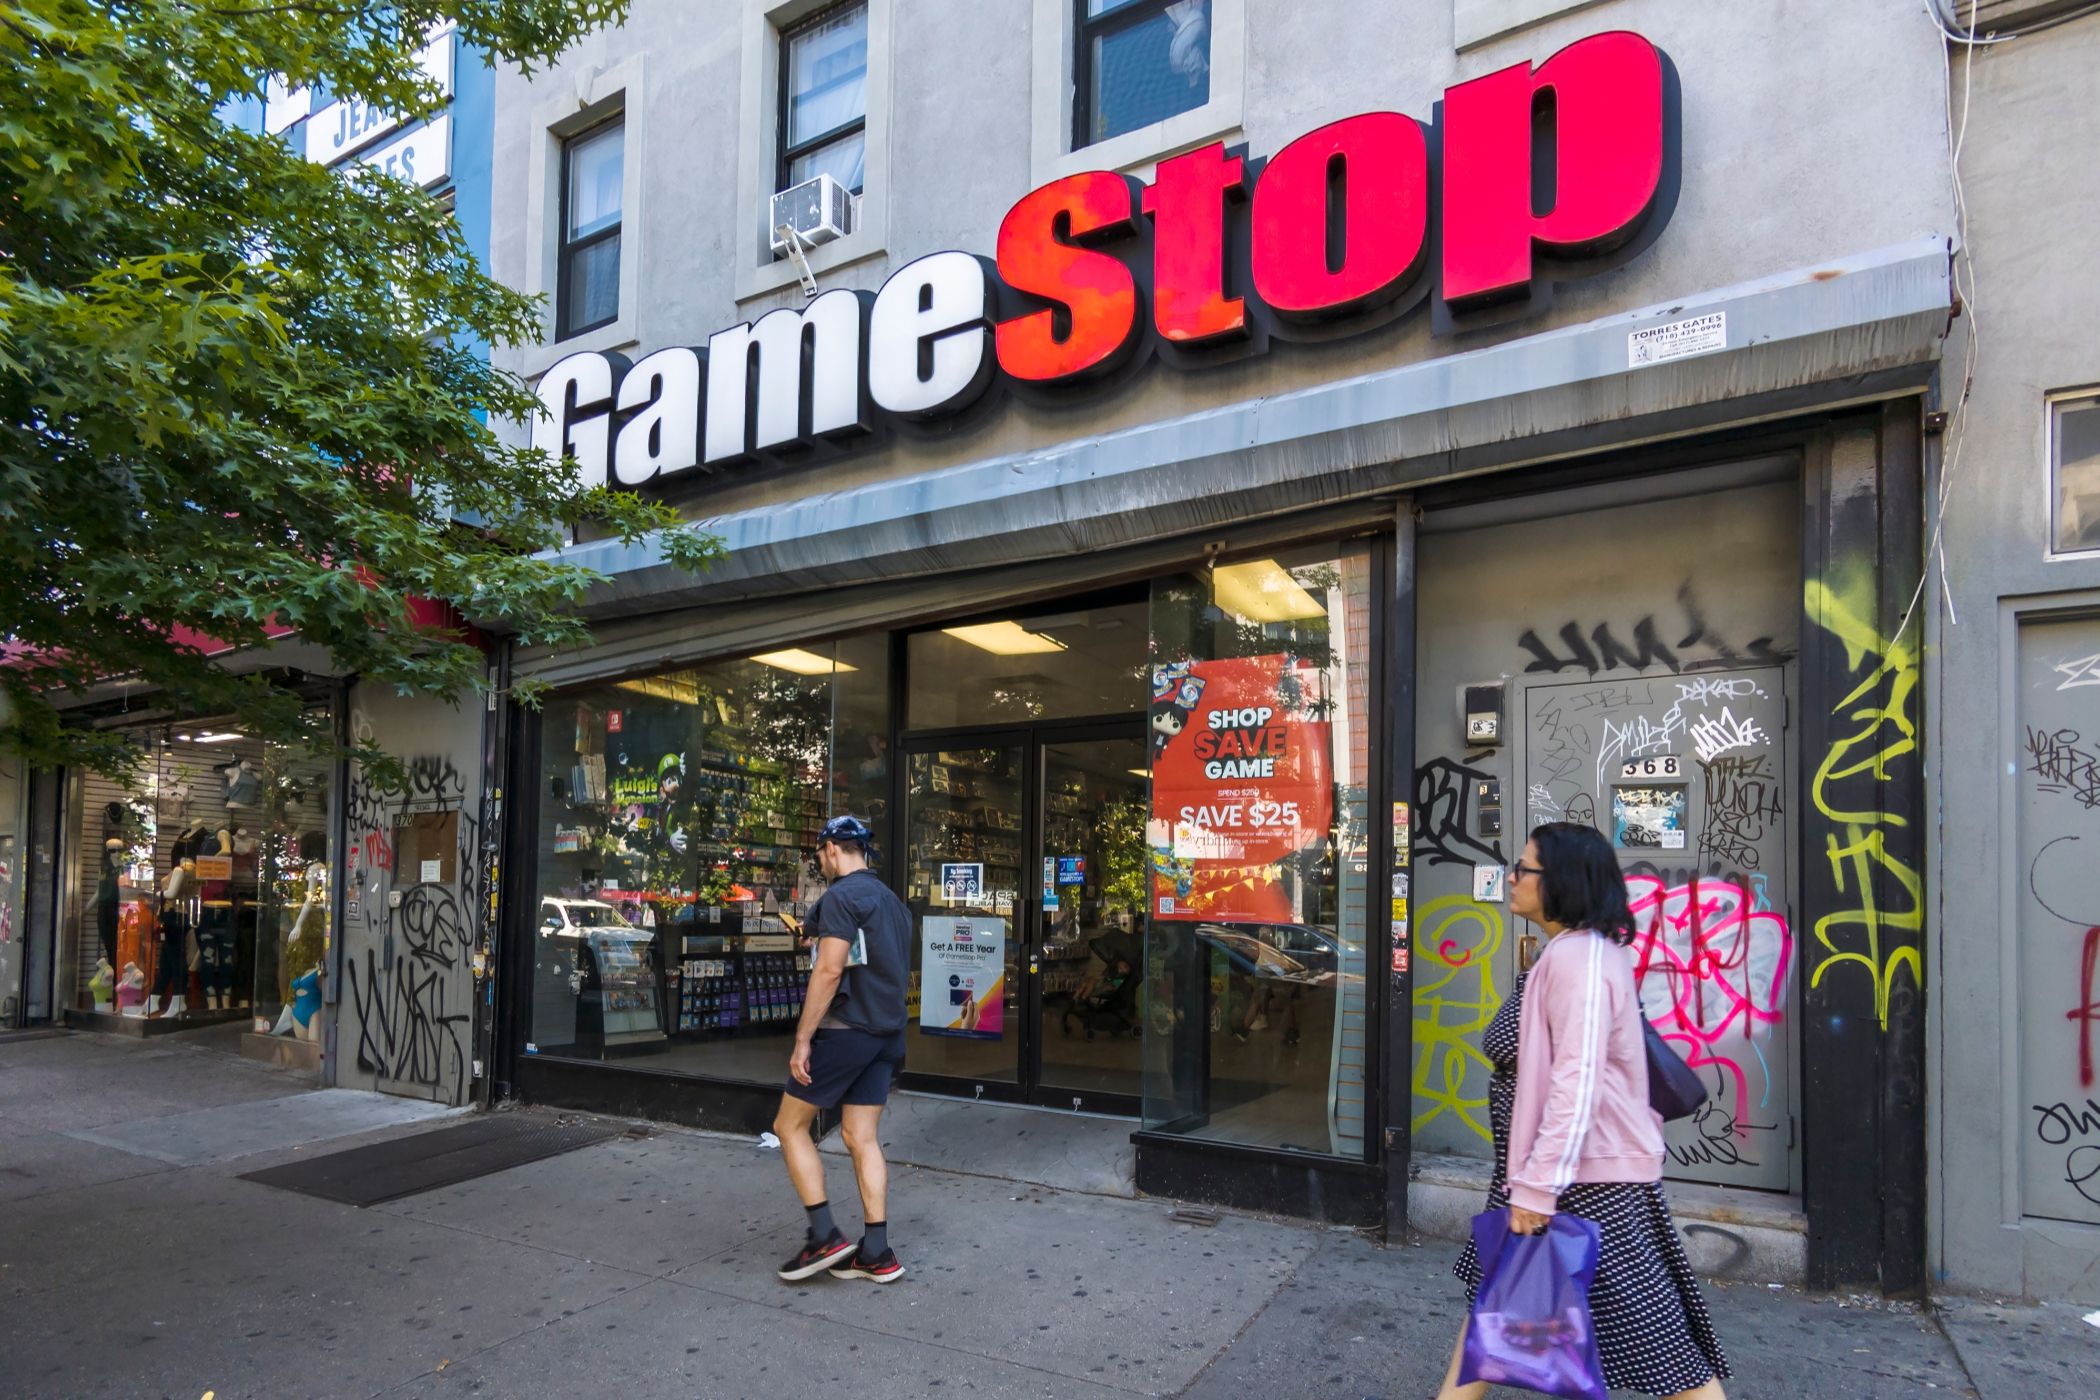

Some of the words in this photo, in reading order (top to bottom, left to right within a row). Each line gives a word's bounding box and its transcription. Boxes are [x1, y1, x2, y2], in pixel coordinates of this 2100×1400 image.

[1632, 324, 1679, 341] TORRES
[1682, 314, 1722, 329] GATES
[1208, 707, 1272, 729] SHOP
[1195, 727, 1287, 760] SAVE
[1205, 758, 1274, 779] GAME
[1625, 757, 1677, 776] 368
[615, 777, 658, 794] Luigi's
[1218, 789, 1240, 797] SPEND
[1180, 804, 1243, 827] SAVE
[1249, 801, 1299, 828] $25
[930, 942, 945, 951] Get
[947, 943, 953, 952] A
[955, 943, 974, 953] FREE
[976, 943, 996, 954] Year
